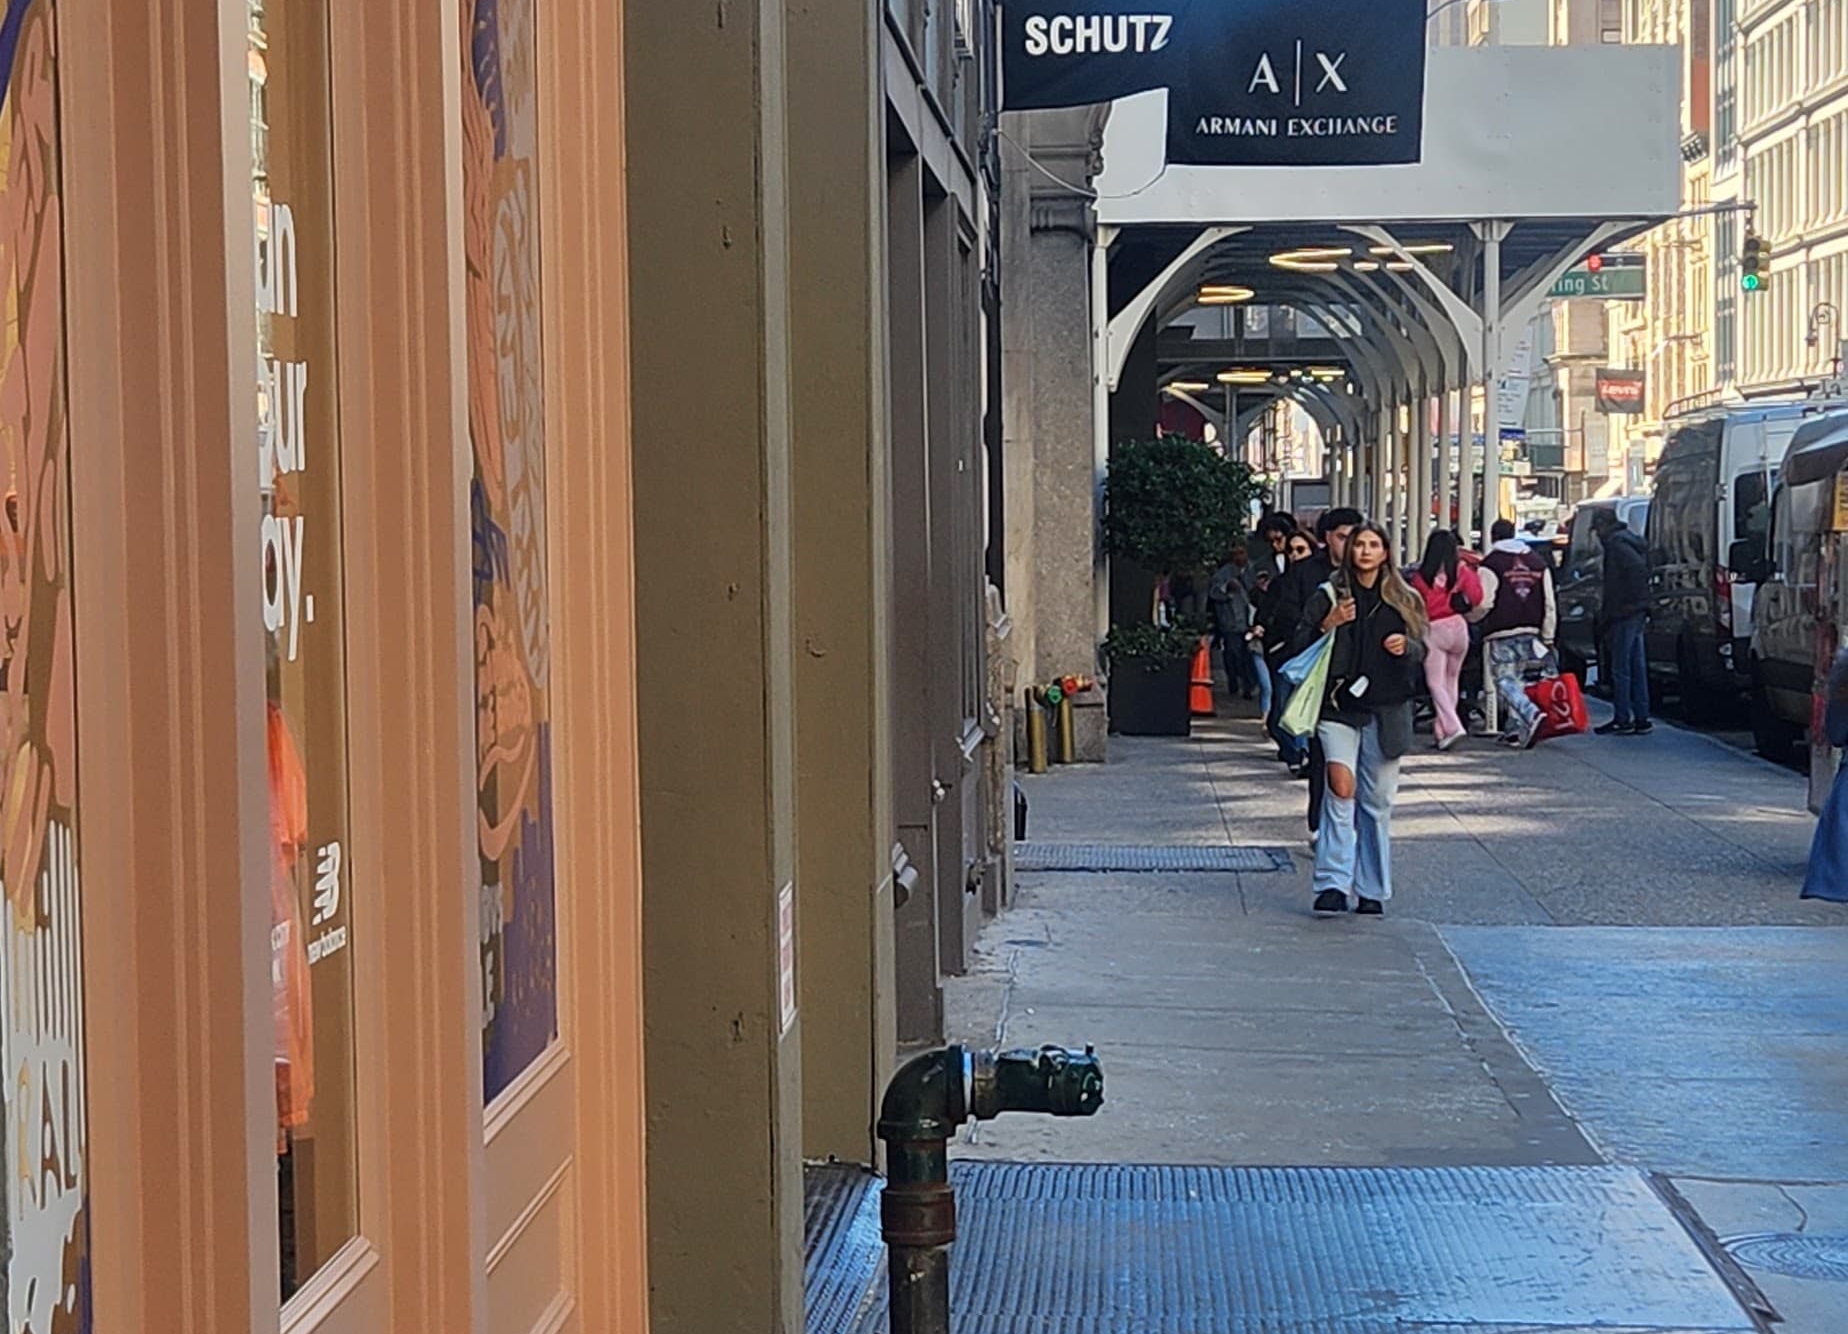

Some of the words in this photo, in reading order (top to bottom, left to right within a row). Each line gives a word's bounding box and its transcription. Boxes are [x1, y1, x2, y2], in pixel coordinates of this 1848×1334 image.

[1024, 14, 1174, 56] SCHUTZ
[1195, 116, 1278, 137] ARMANI
[1287, 115, 1398, 137] EXCHANGE
[1591, 275, 1609, 292] St
[1551, 680, 1575, 730] C21
